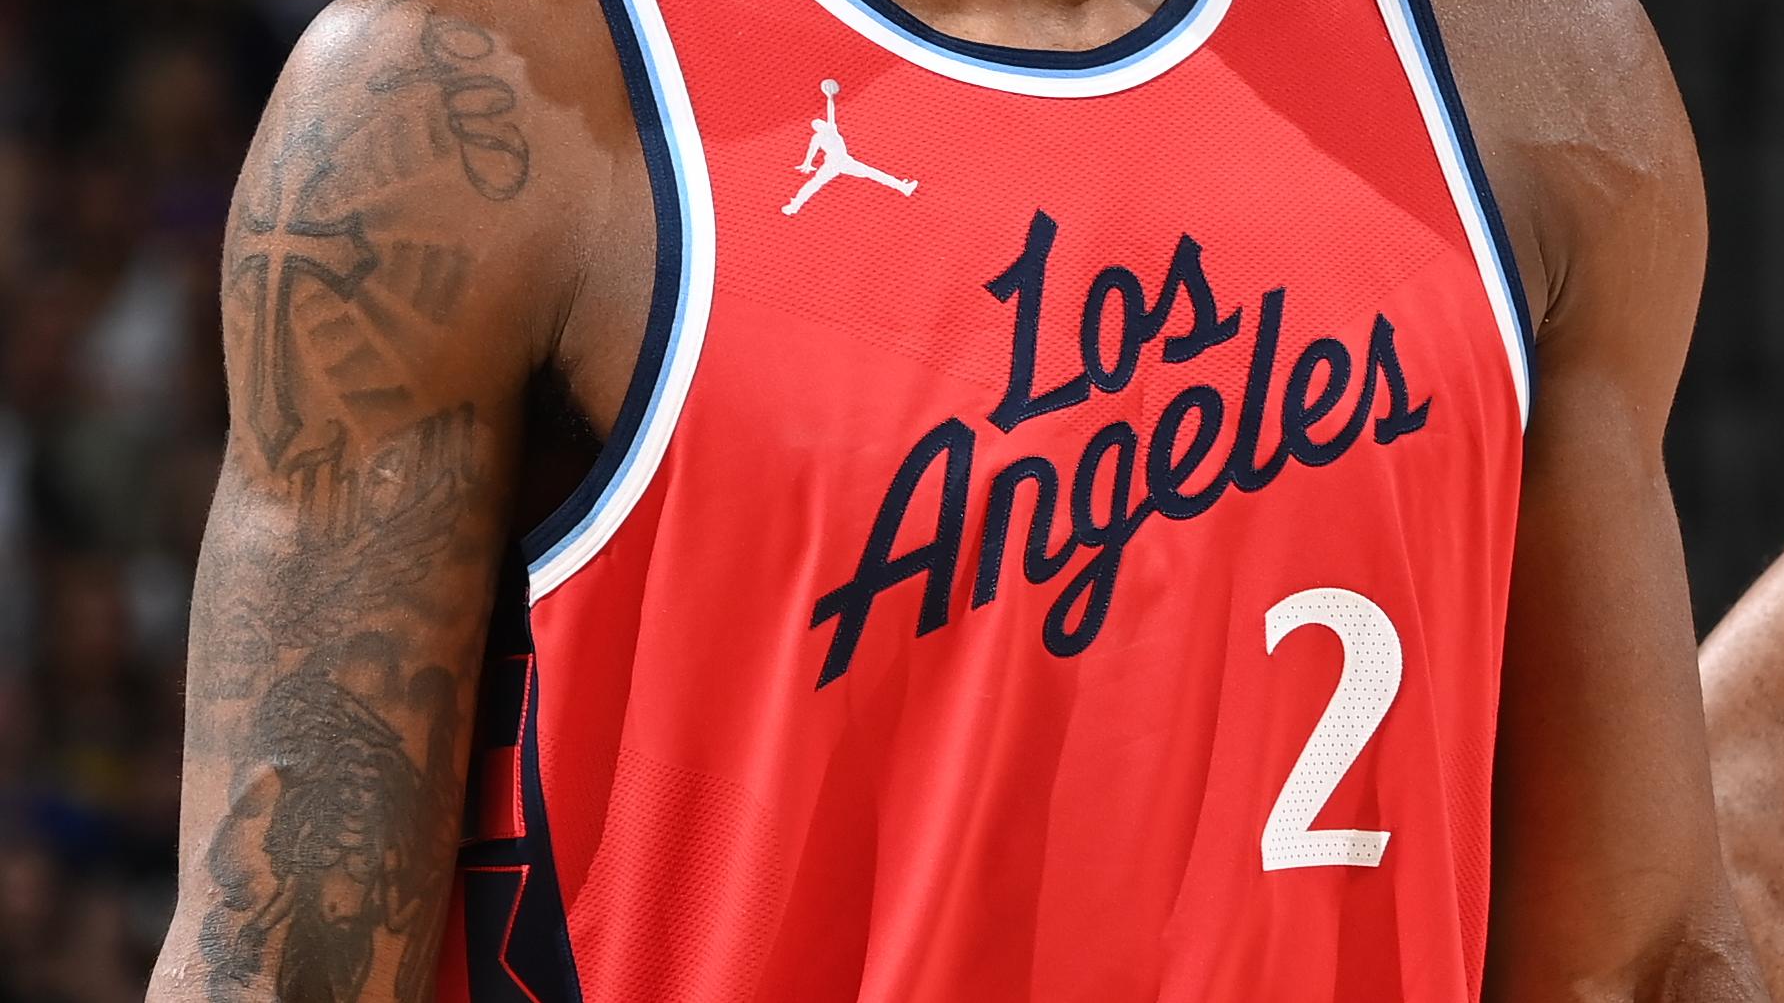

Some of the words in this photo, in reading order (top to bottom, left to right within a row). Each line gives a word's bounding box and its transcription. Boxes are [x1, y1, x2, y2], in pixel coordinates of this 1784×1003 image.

[982, 208, 1243, 433] Los
[810, 286, 1433, 692] Angeles
[1260, 587, 1403, 872] 2
